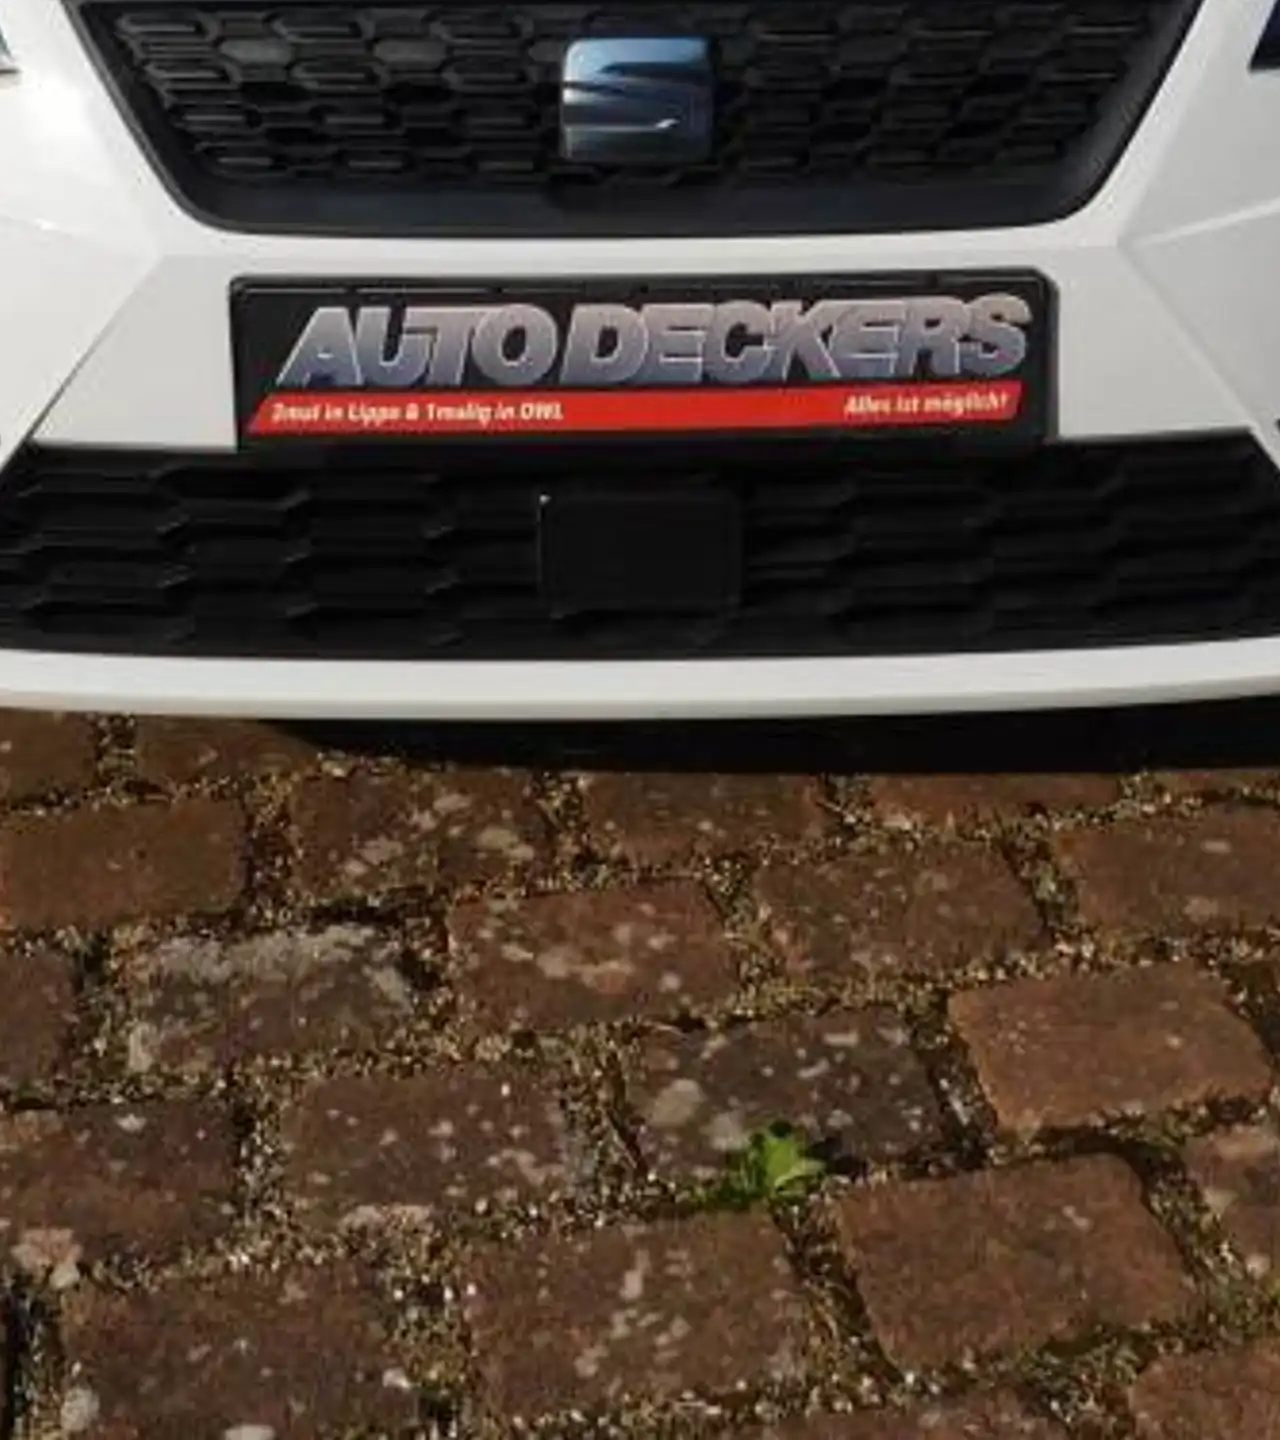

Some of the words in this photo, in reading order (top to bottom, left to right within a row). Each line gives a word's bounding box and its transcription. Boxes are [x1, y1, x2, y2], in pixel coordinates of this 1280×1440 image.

[274, 302, 557, 388] AUTO
[559, 292, 1033, 384] DECKERS
[844, 394, 892, 415] Alles
[896, 393, 920, 414] ist
